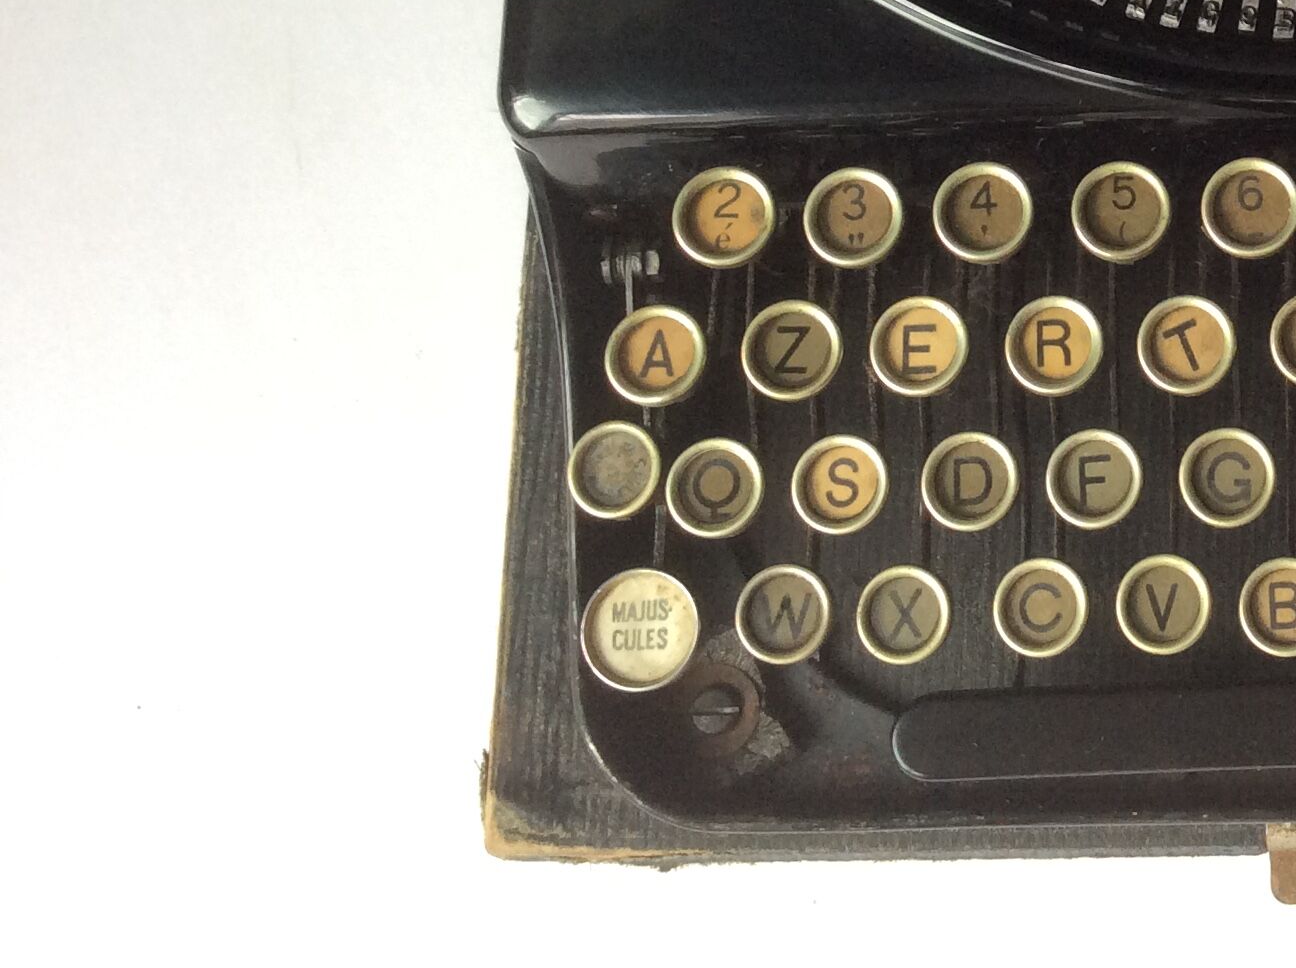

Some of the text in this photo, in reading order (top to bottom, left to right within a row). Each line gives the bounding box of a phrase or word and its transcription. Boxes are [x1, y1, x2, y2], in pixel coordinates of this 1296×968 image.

[714, 182, 741, 219] 2
[842, 183, 866, 220] 3
[970, 181, 997, 217] 4
[1112, 177, 1136, 210] 5
[1238, 176, 1263, 211] 6
[715, 222, 734, 250] é
[640, 329, 674, 378] A
[774, 326, 810, 375] Z
[901, 324, 938, 375] E
[1037, 318, 1072, 368] R
[1162, 318, 1201, 372] T
[693, 457, 741, 520] Q
[825, 457, 859, 509] S
[952, 455, 993, 507] D
[1078, 453, 1111, 510] F
[1206, 451, 1252, 503] G
[762, 591, 811, 639] W
[889, 588, 922, 638] X
[1018, 582, 1062, 631] C
[1145, 583, 1178, 632] V
[612, 628, 668, 651] CULES
